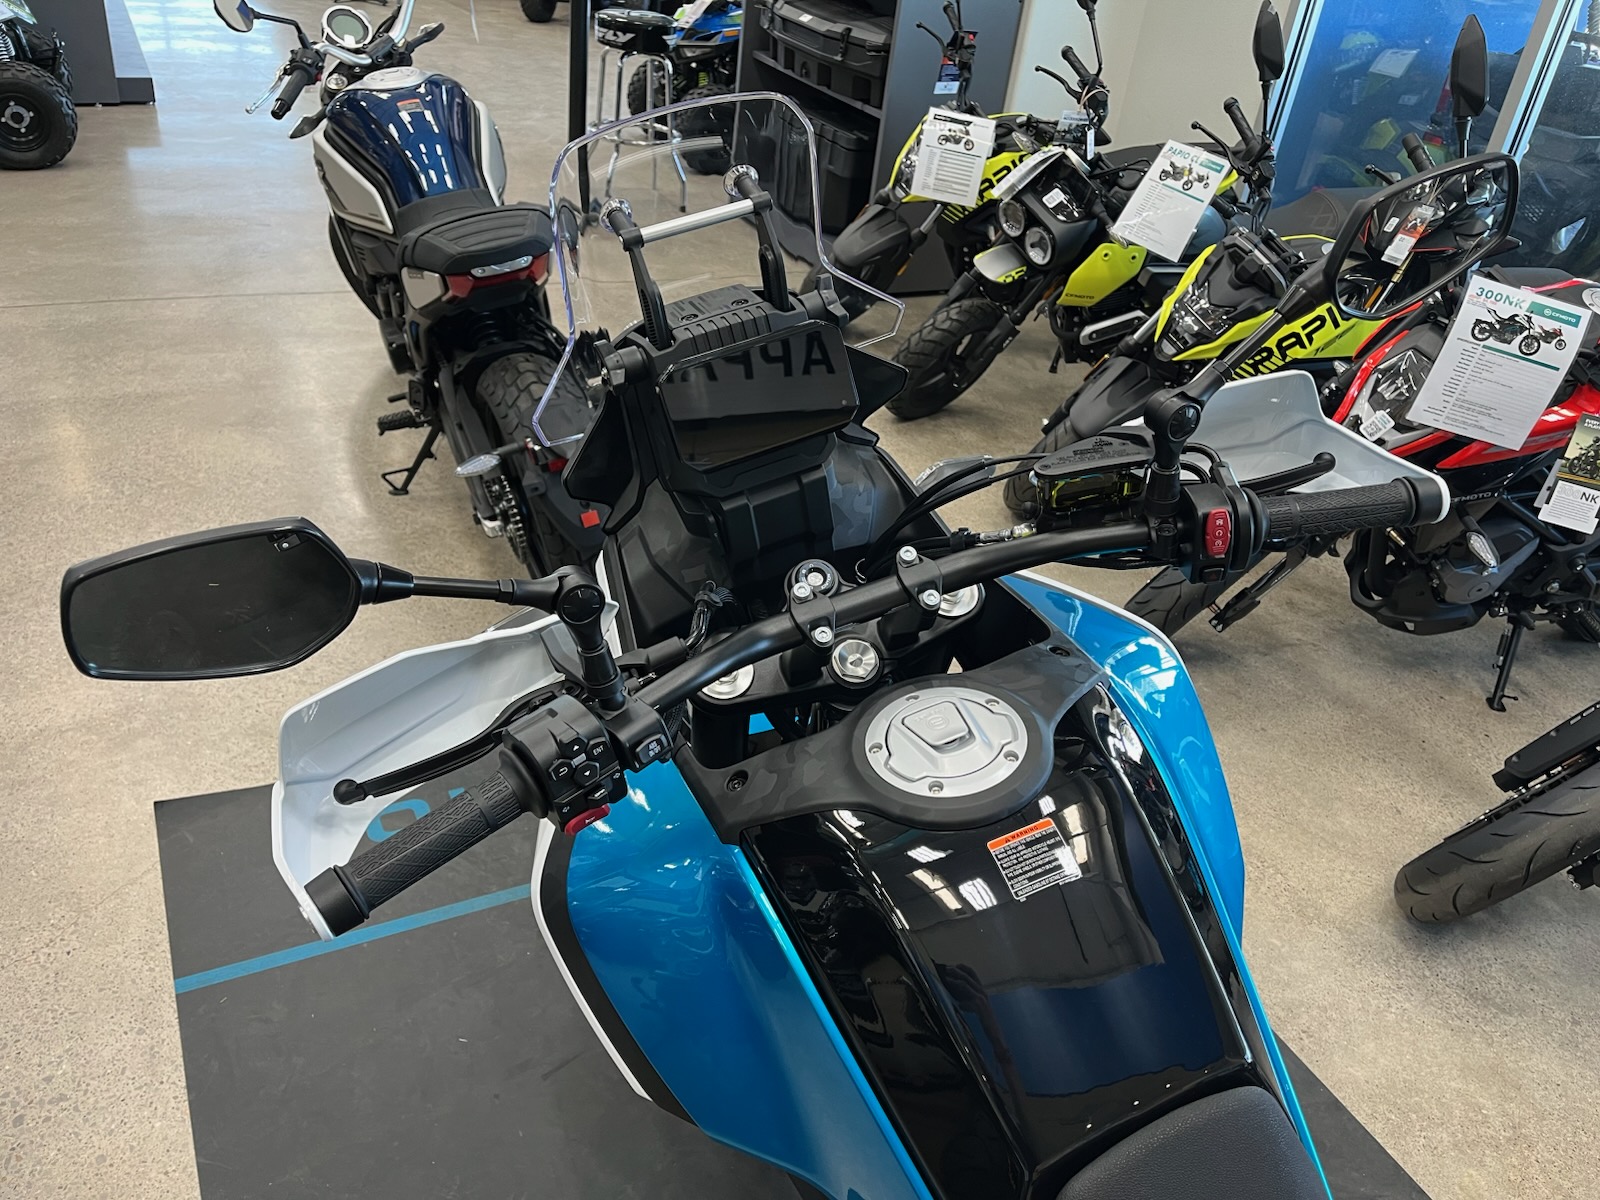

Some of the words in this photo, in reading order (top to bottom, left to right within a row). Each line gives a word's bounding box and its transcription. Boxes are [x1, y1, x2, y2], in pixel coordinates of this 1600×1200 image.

[1475, 286, 1526, 310] 300NK
[1551, 312, 1577, 323] CFMOTO
[592, 744, 604, 756] ENT
[1011, 825, 1039, 840] WARNING
